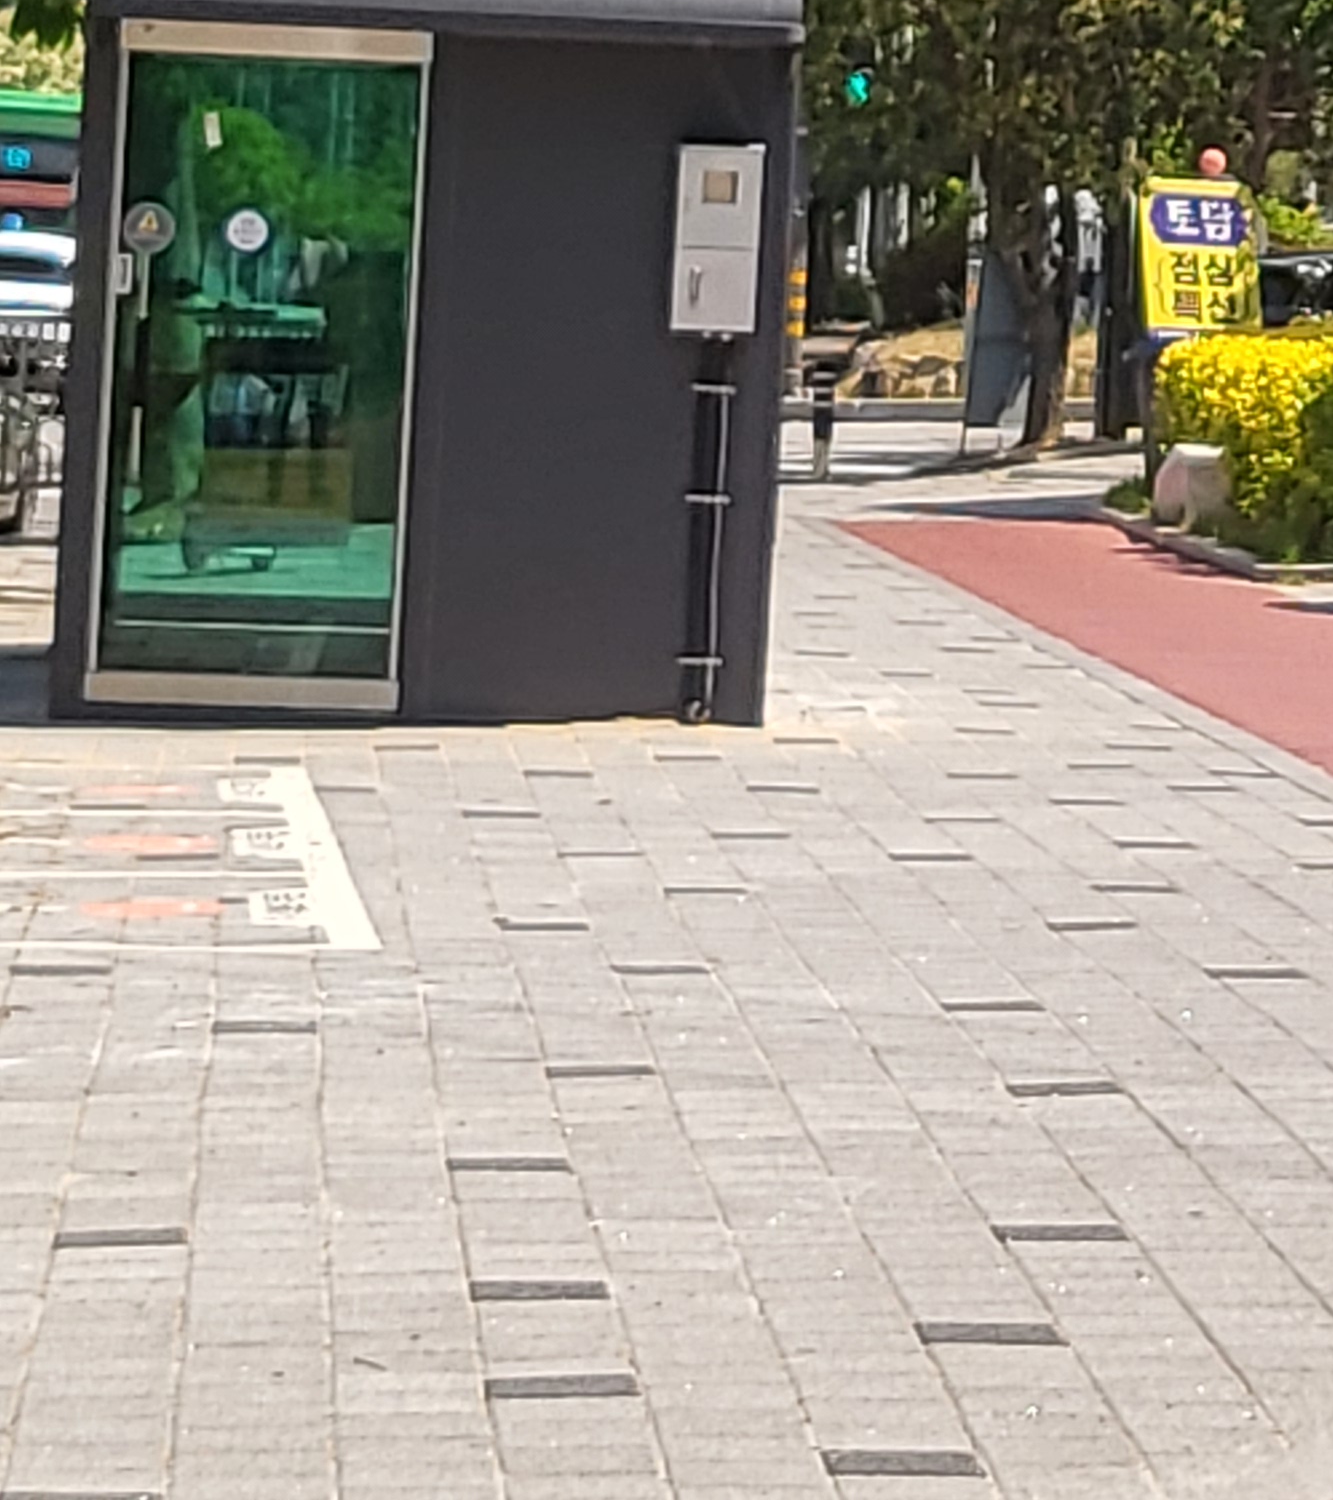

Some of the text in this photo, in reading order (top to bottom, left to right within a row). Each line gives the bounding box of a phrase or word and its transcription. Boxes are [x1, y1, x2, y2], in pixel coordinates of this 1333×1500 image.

[1165, 199, 1236, 243] 토담
[1170, 251, 1236, 287] 점심
[1172, 291, 1240, 324] 특선
